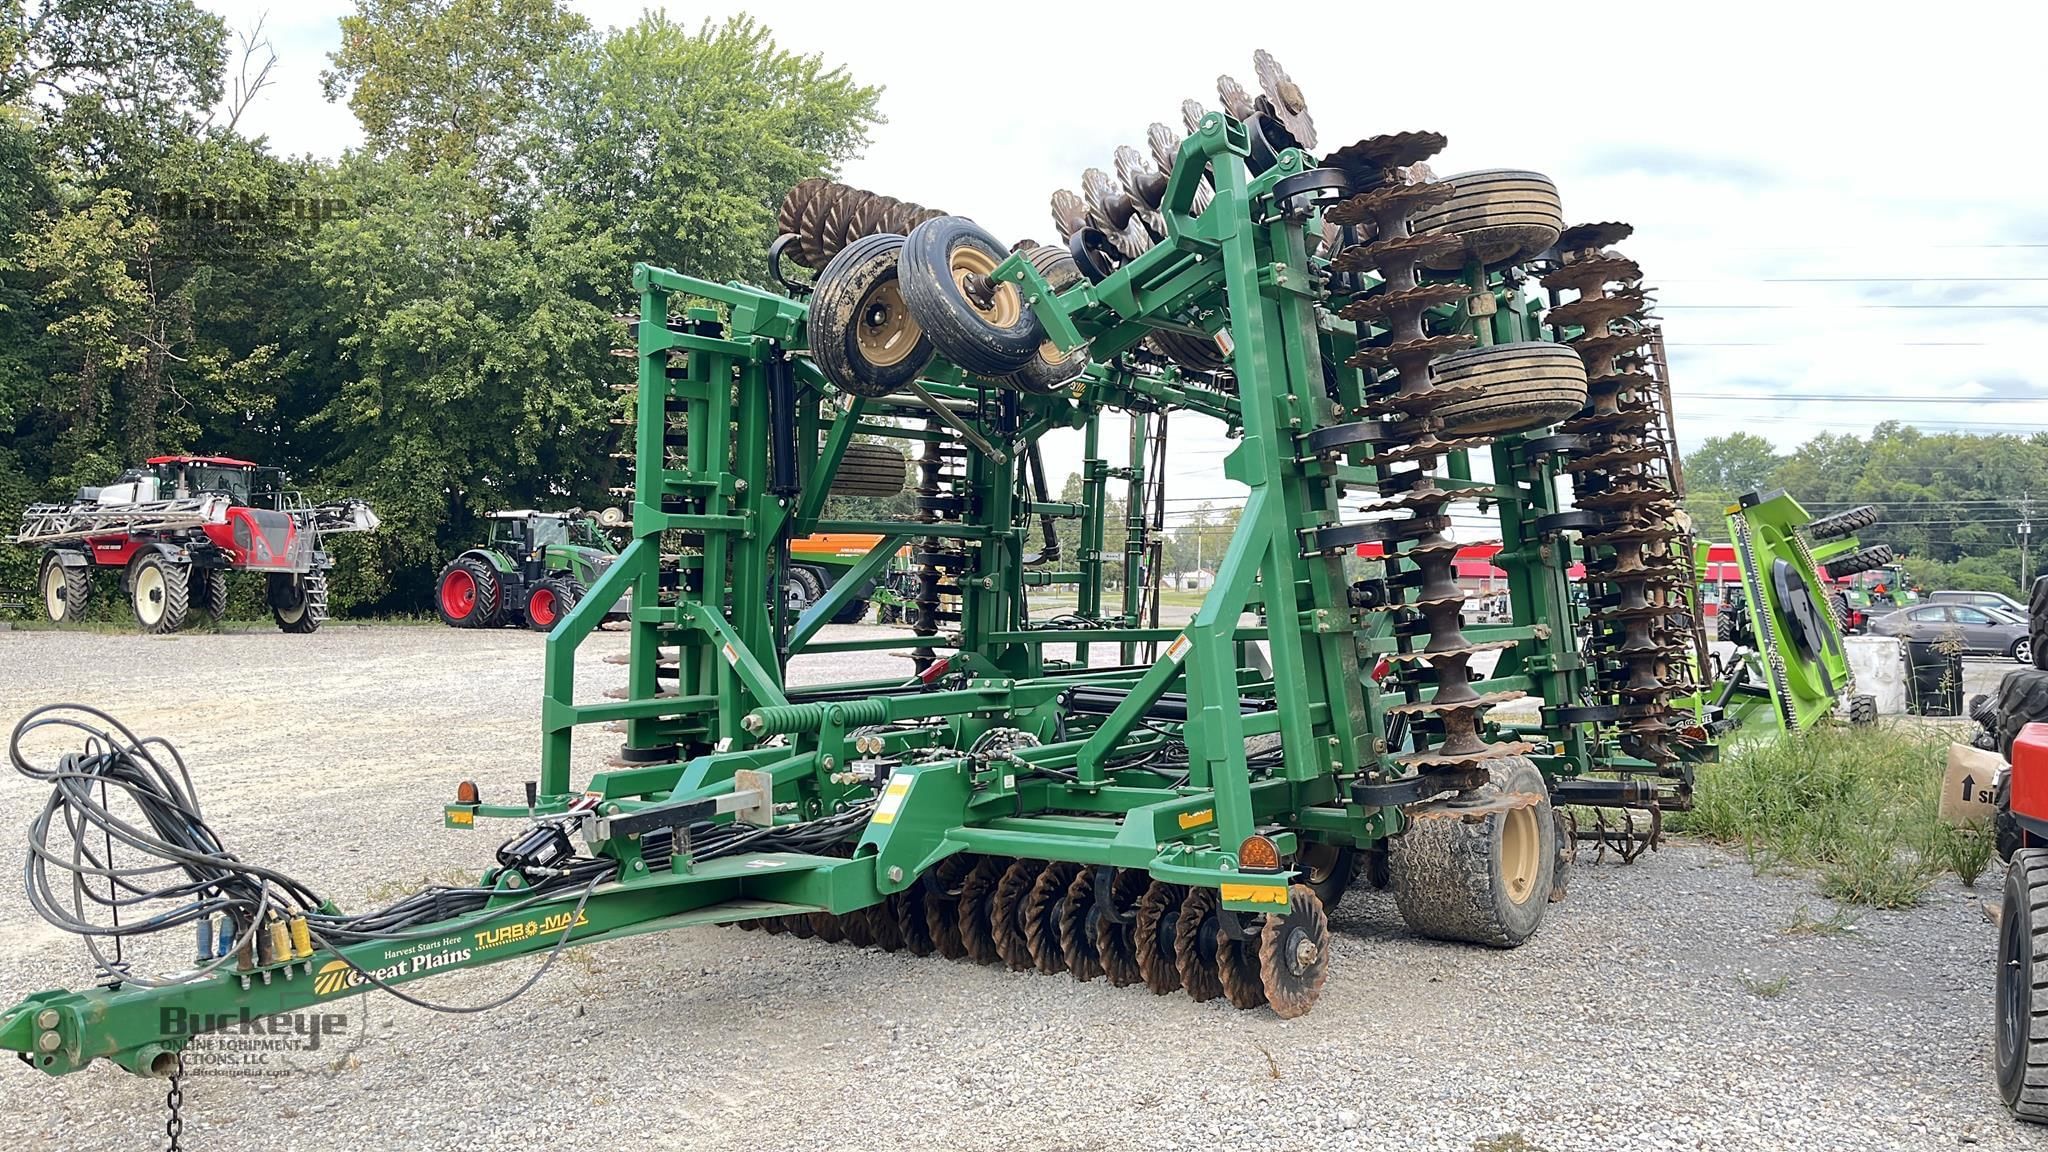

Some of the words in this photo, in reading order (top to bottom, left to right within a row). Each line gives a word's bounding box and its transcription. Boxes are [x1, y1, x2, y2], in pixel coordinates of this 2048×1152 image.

[1978, 790, 2000, 806] SI
[475, 909, 588, 947] TURBO-MAX
[384, 948, 416, 960] Harvest
[417, 942, 441, 952] Starts
[442, 936, 462, 946] Here
[347, 960, 408, 987] Great
[410, 950, 471, 973] Plains
